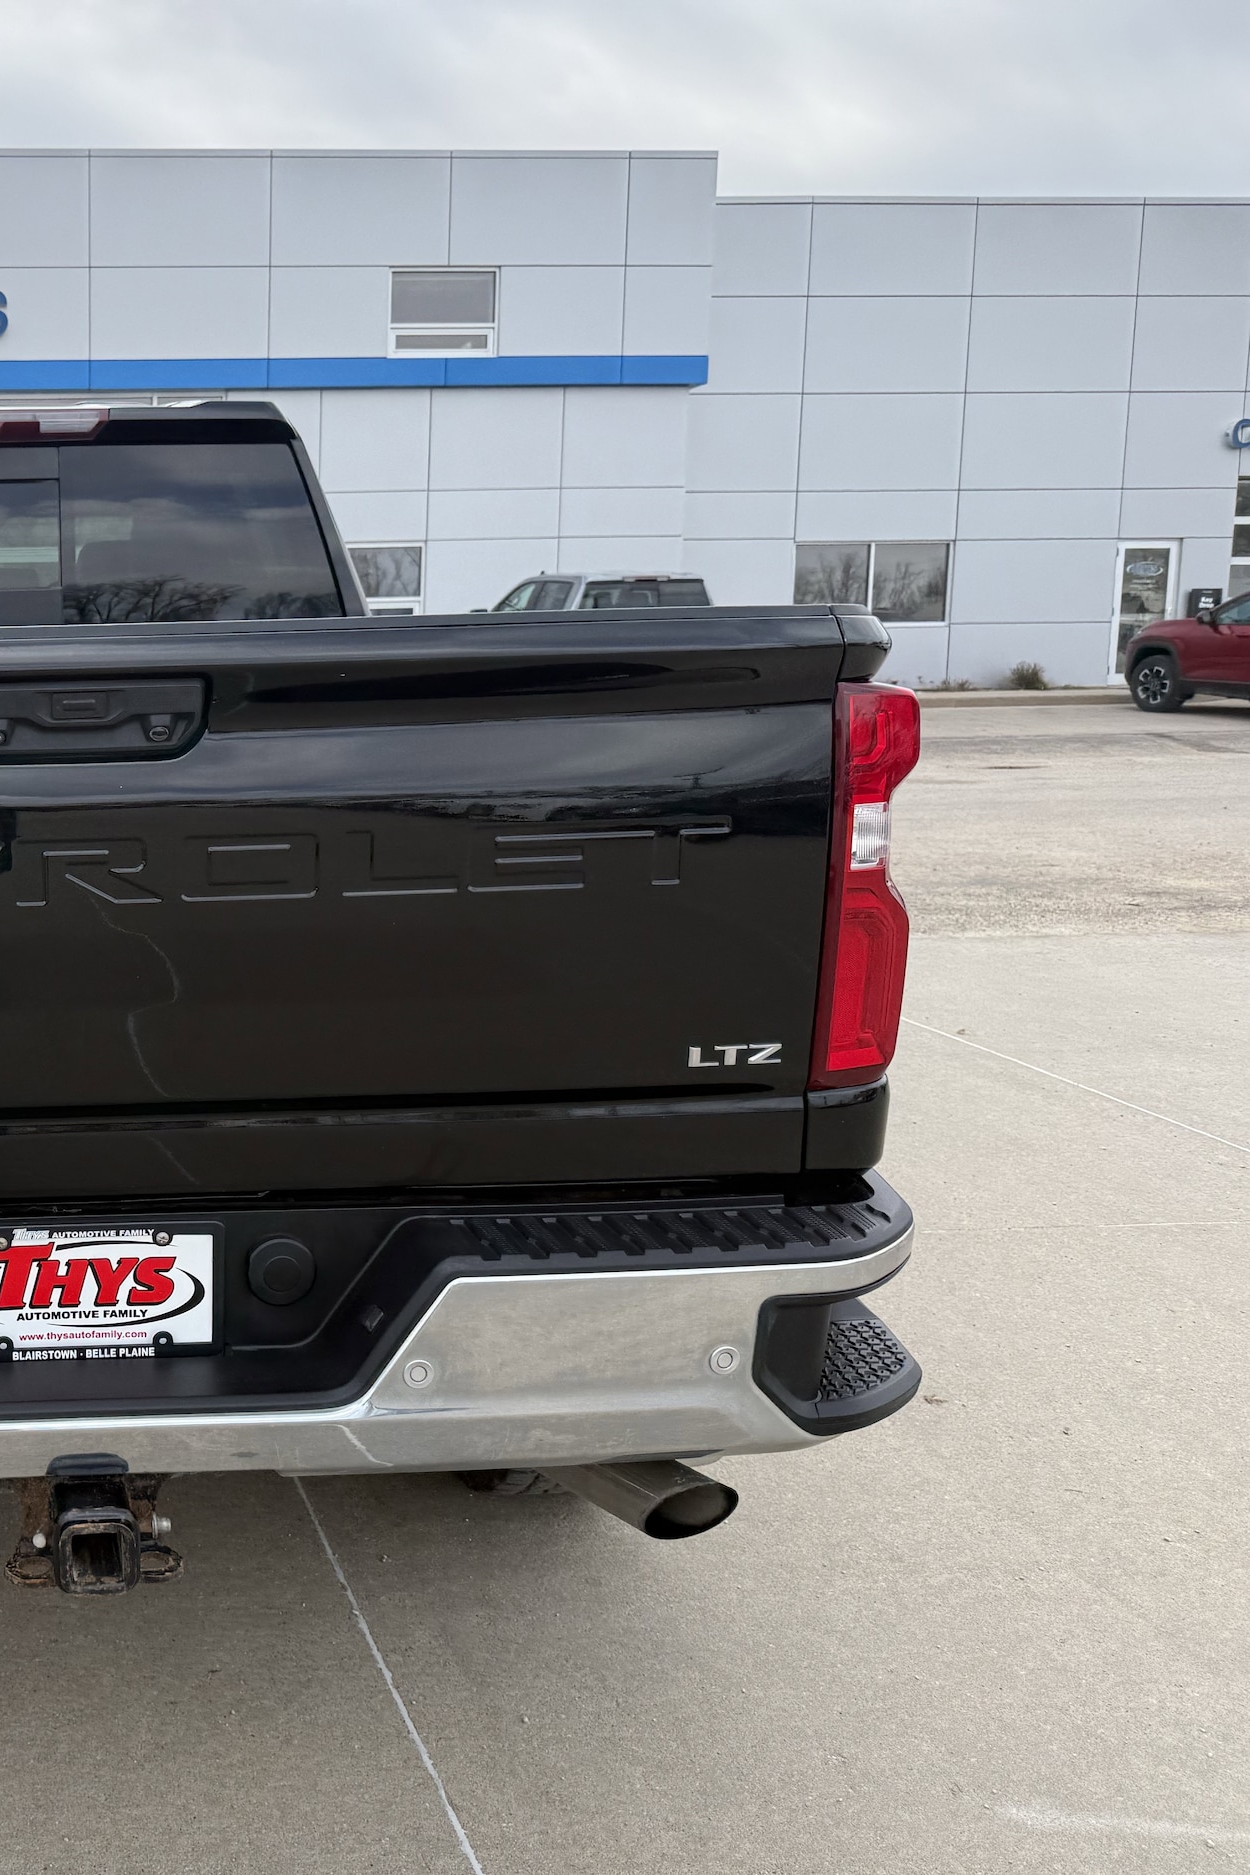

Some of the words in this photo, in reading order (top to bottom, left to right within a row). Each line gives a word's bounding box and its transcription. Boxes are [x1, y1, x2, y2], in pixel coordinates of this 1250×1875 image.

[688, 1043, 782, 1067] LTZ
[52, 1230, 117, 1239] AUTOMOTIVE
[119, 1228, 155, 1237] FAMILY
[16, 1310, 99, 1321] AUTOMOTIVE
[102, 1308, 148, 1319] FAMILY
[19, 1329, 148, 1342] www.thysautofamily.com
[12, 1349, 78, 1362] BLAIRSTOWN
[85, 1348, 117, 1359] BELLE
[119, 1346, 156, 1358] PLAINE
